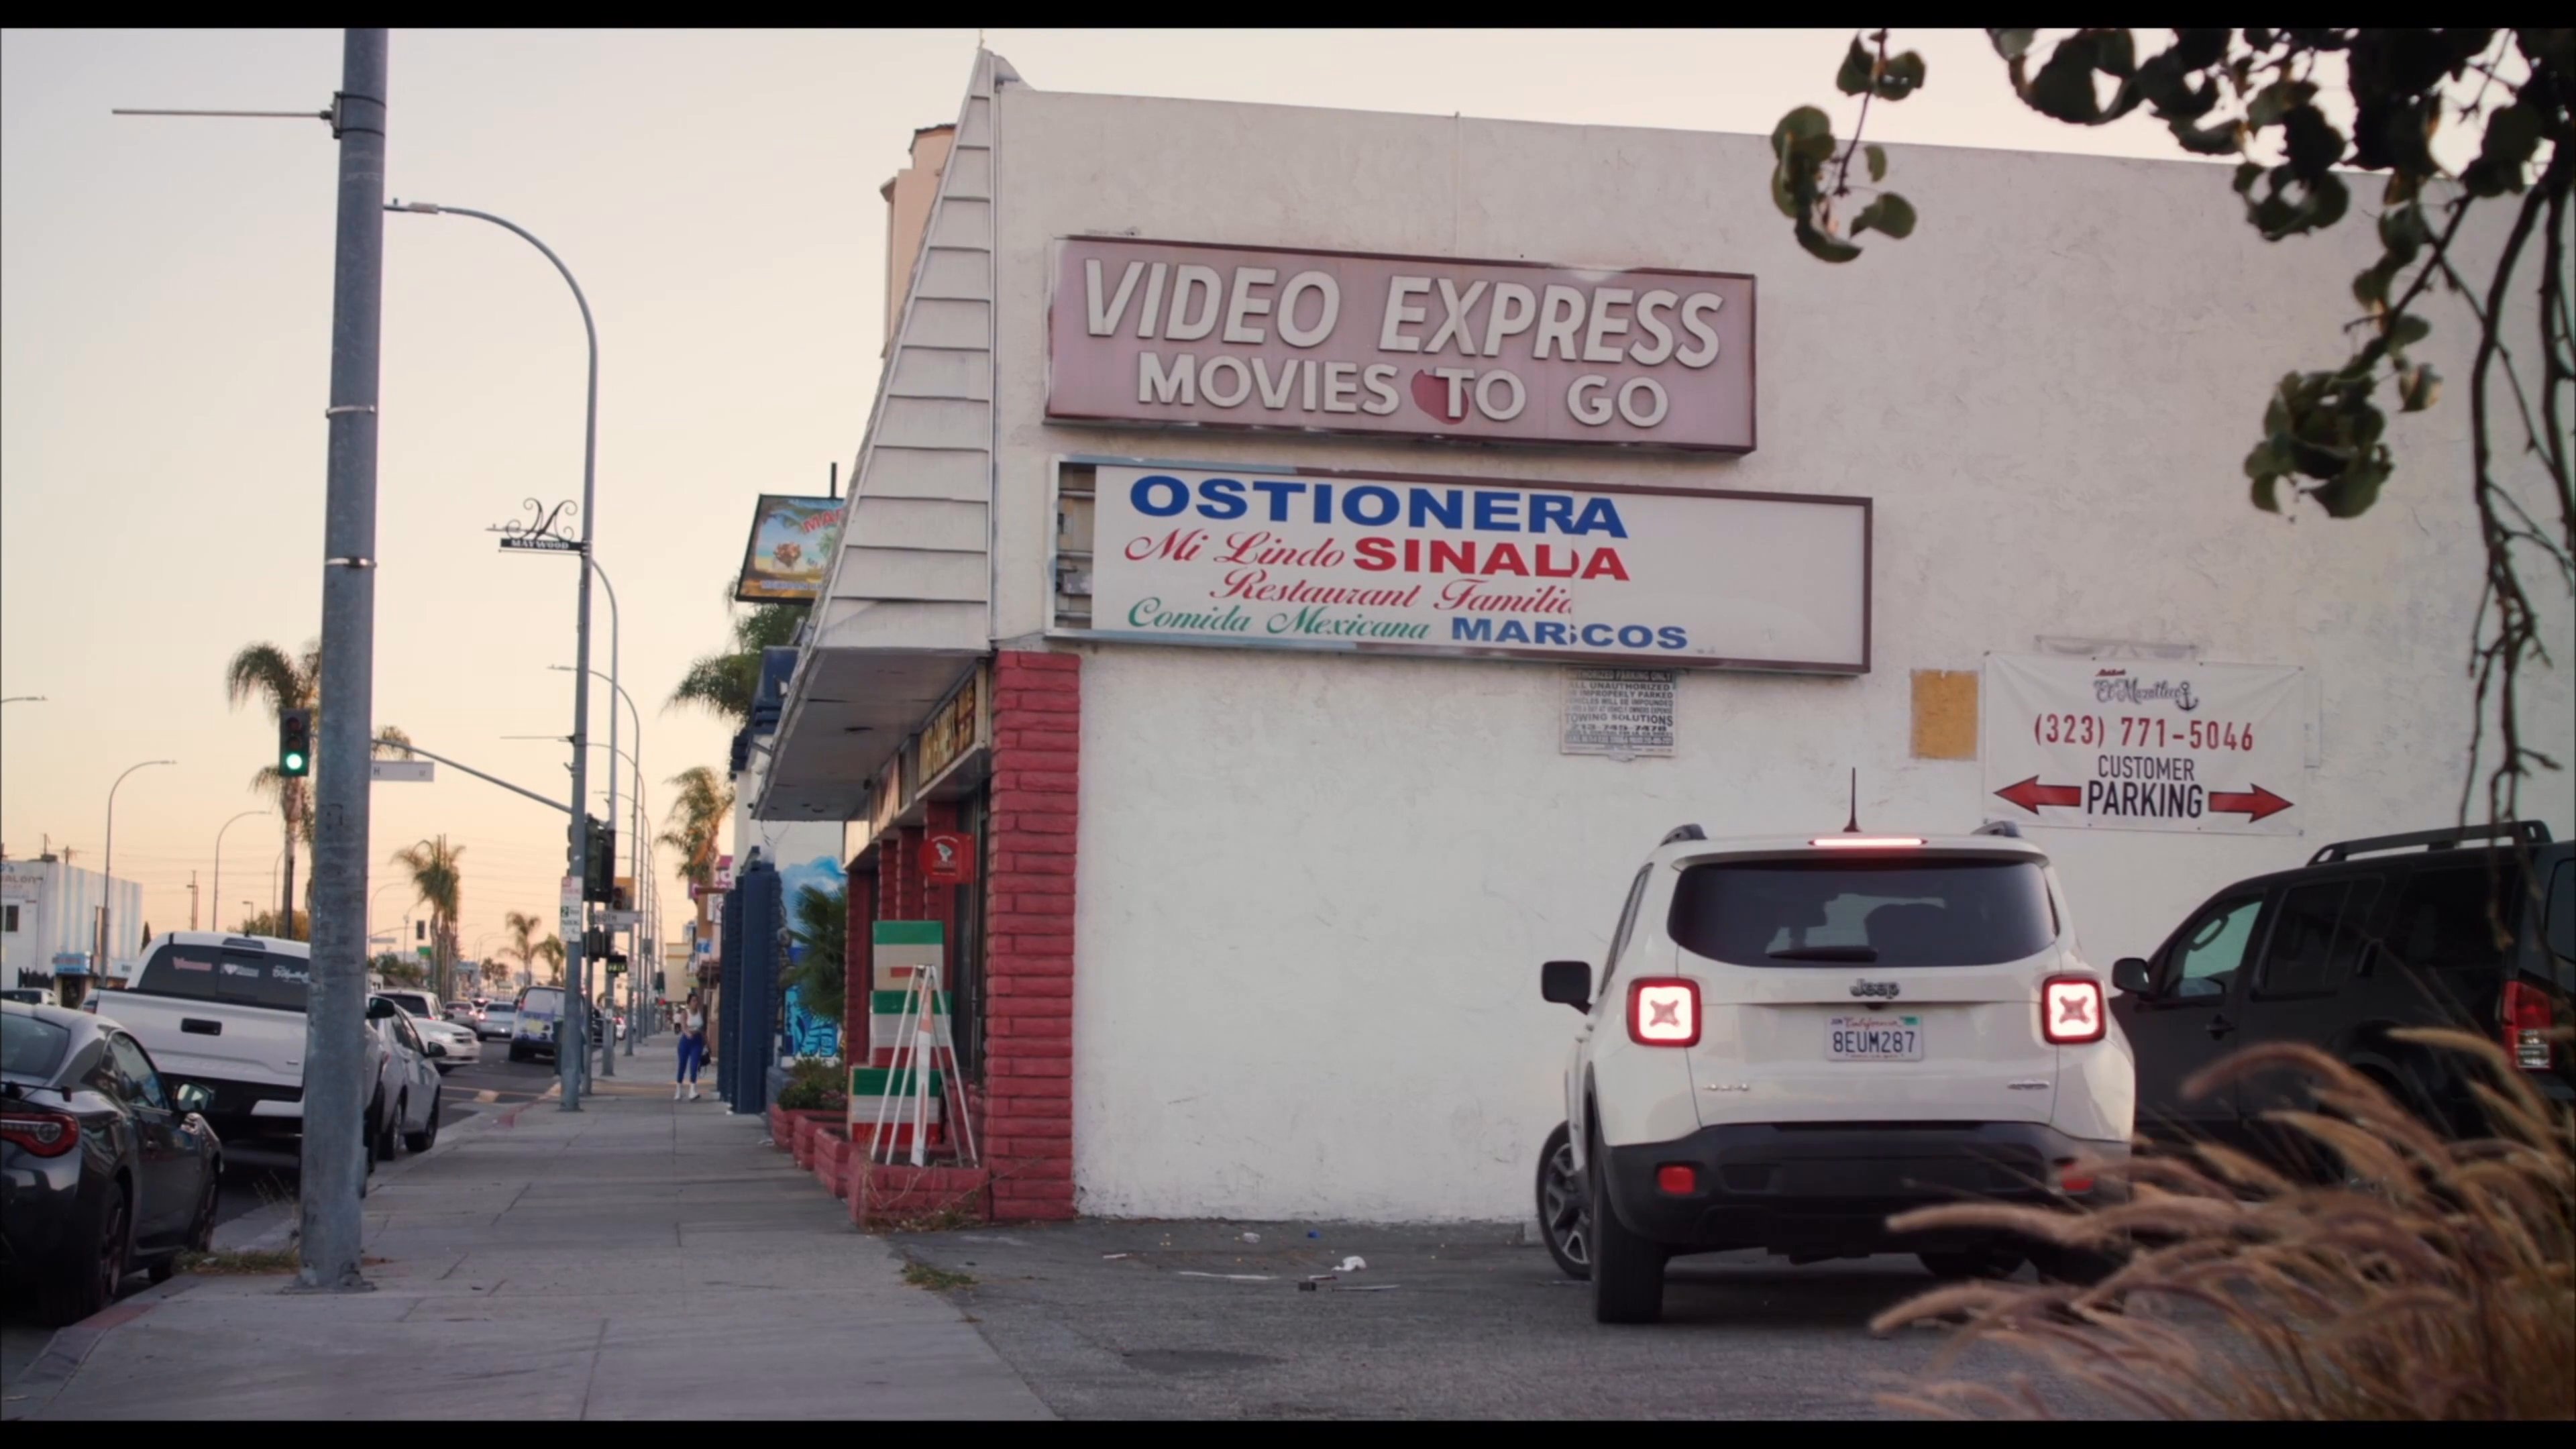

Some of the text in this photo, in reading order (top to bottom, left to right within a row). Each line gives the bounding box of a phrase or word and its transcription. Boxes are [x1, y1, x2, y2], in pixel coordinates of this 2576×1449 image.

[1083, 258, 1724, 368] VIDEO EXPRESS
[1137, 351, 1670, 428] MOVIES TO GO
[1129, 474, 1629, 539] OSTIONERA
[511, 539, 570, 549] MAYWOOD
[1124, 527, 1630, 582] Mi Lindo SINALA
[1208, 568, 1422, 609] Restaurant
[1128, 596, 1252, 633] Comida
[1266, 605, 1432, 639] Mexicana
[1589, 682, 1670, 691] UNAUTHORIZED
[1638, 691, 1673, 700] PARKED
[1566, 712, 1673, 727] TOWING SOLUTIONS
[2034, 713, 2254, 751] (323) 771-5046
[2097, 754, 2195, 782] CUSTOMER
[2086, 780, 2204, 819] PARKING
[1849, 977, 1900, 1000] Jeep
[1843, 1015, 1902, 1030] California
[1832, 1030, 1916, 1053] 8EUM287
